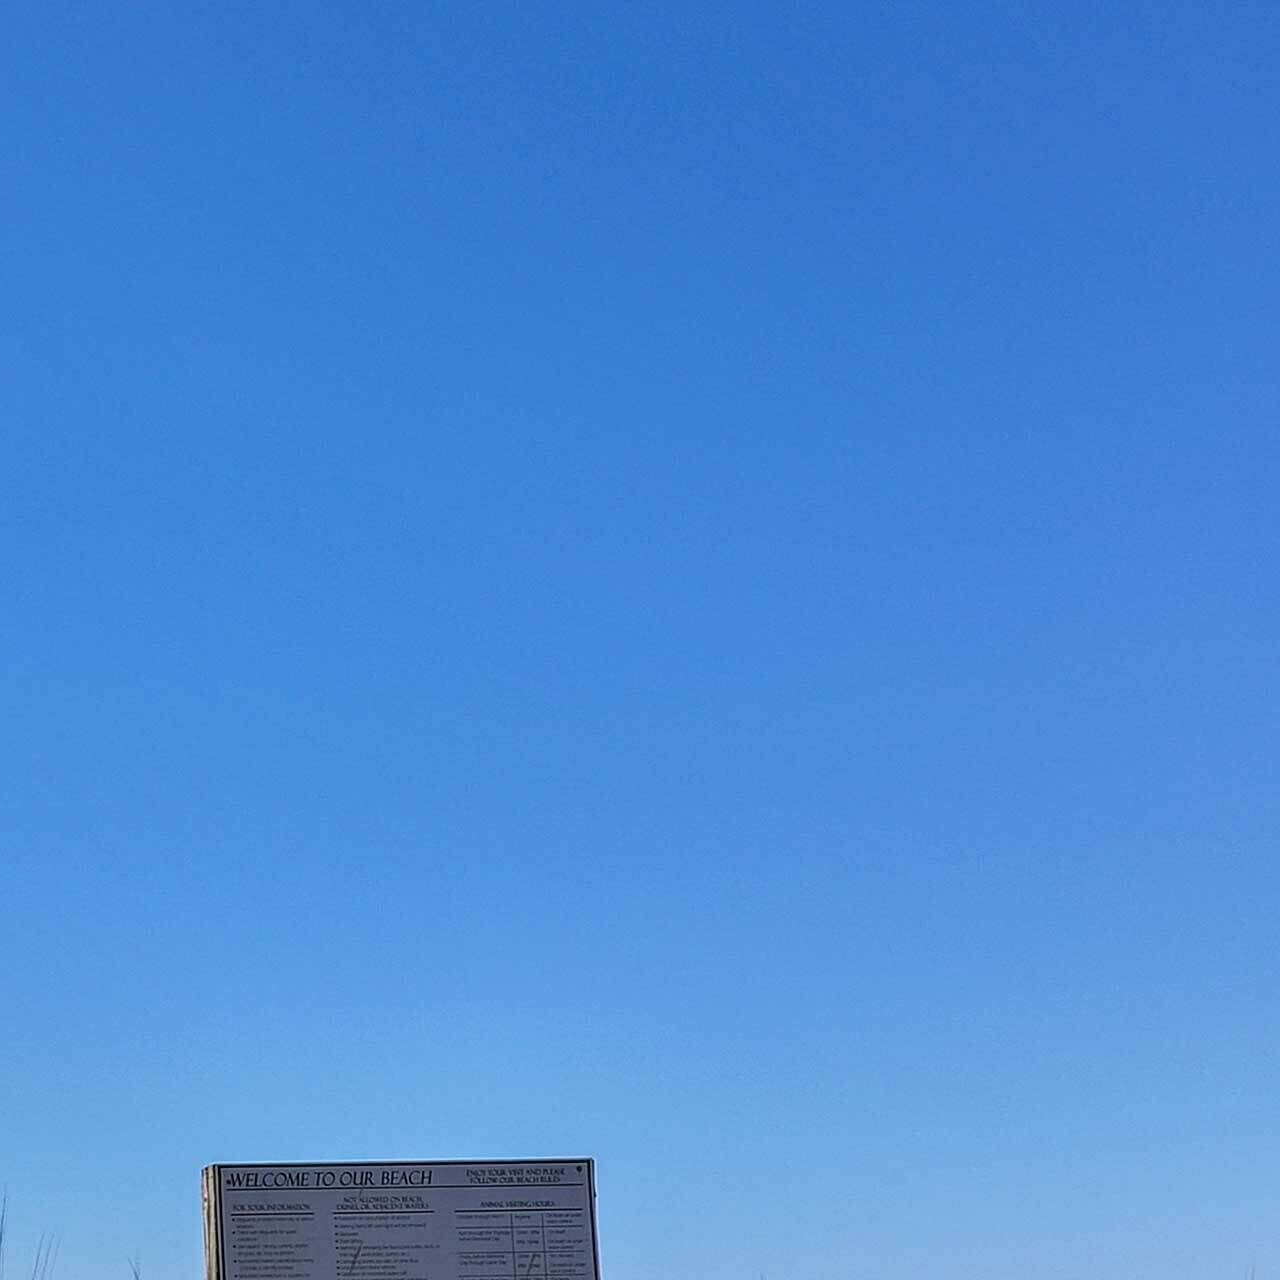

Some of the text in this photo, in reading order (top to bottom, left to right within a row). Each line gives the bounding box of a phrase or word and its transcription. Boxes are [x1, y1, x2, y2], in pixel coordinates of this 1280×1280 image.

[229, 1170, 433, 1187] WELCOME TO OUR BEACH
[466, 1167, 565, 1177] ENJOY YOUR VISIT AND PLEASE
